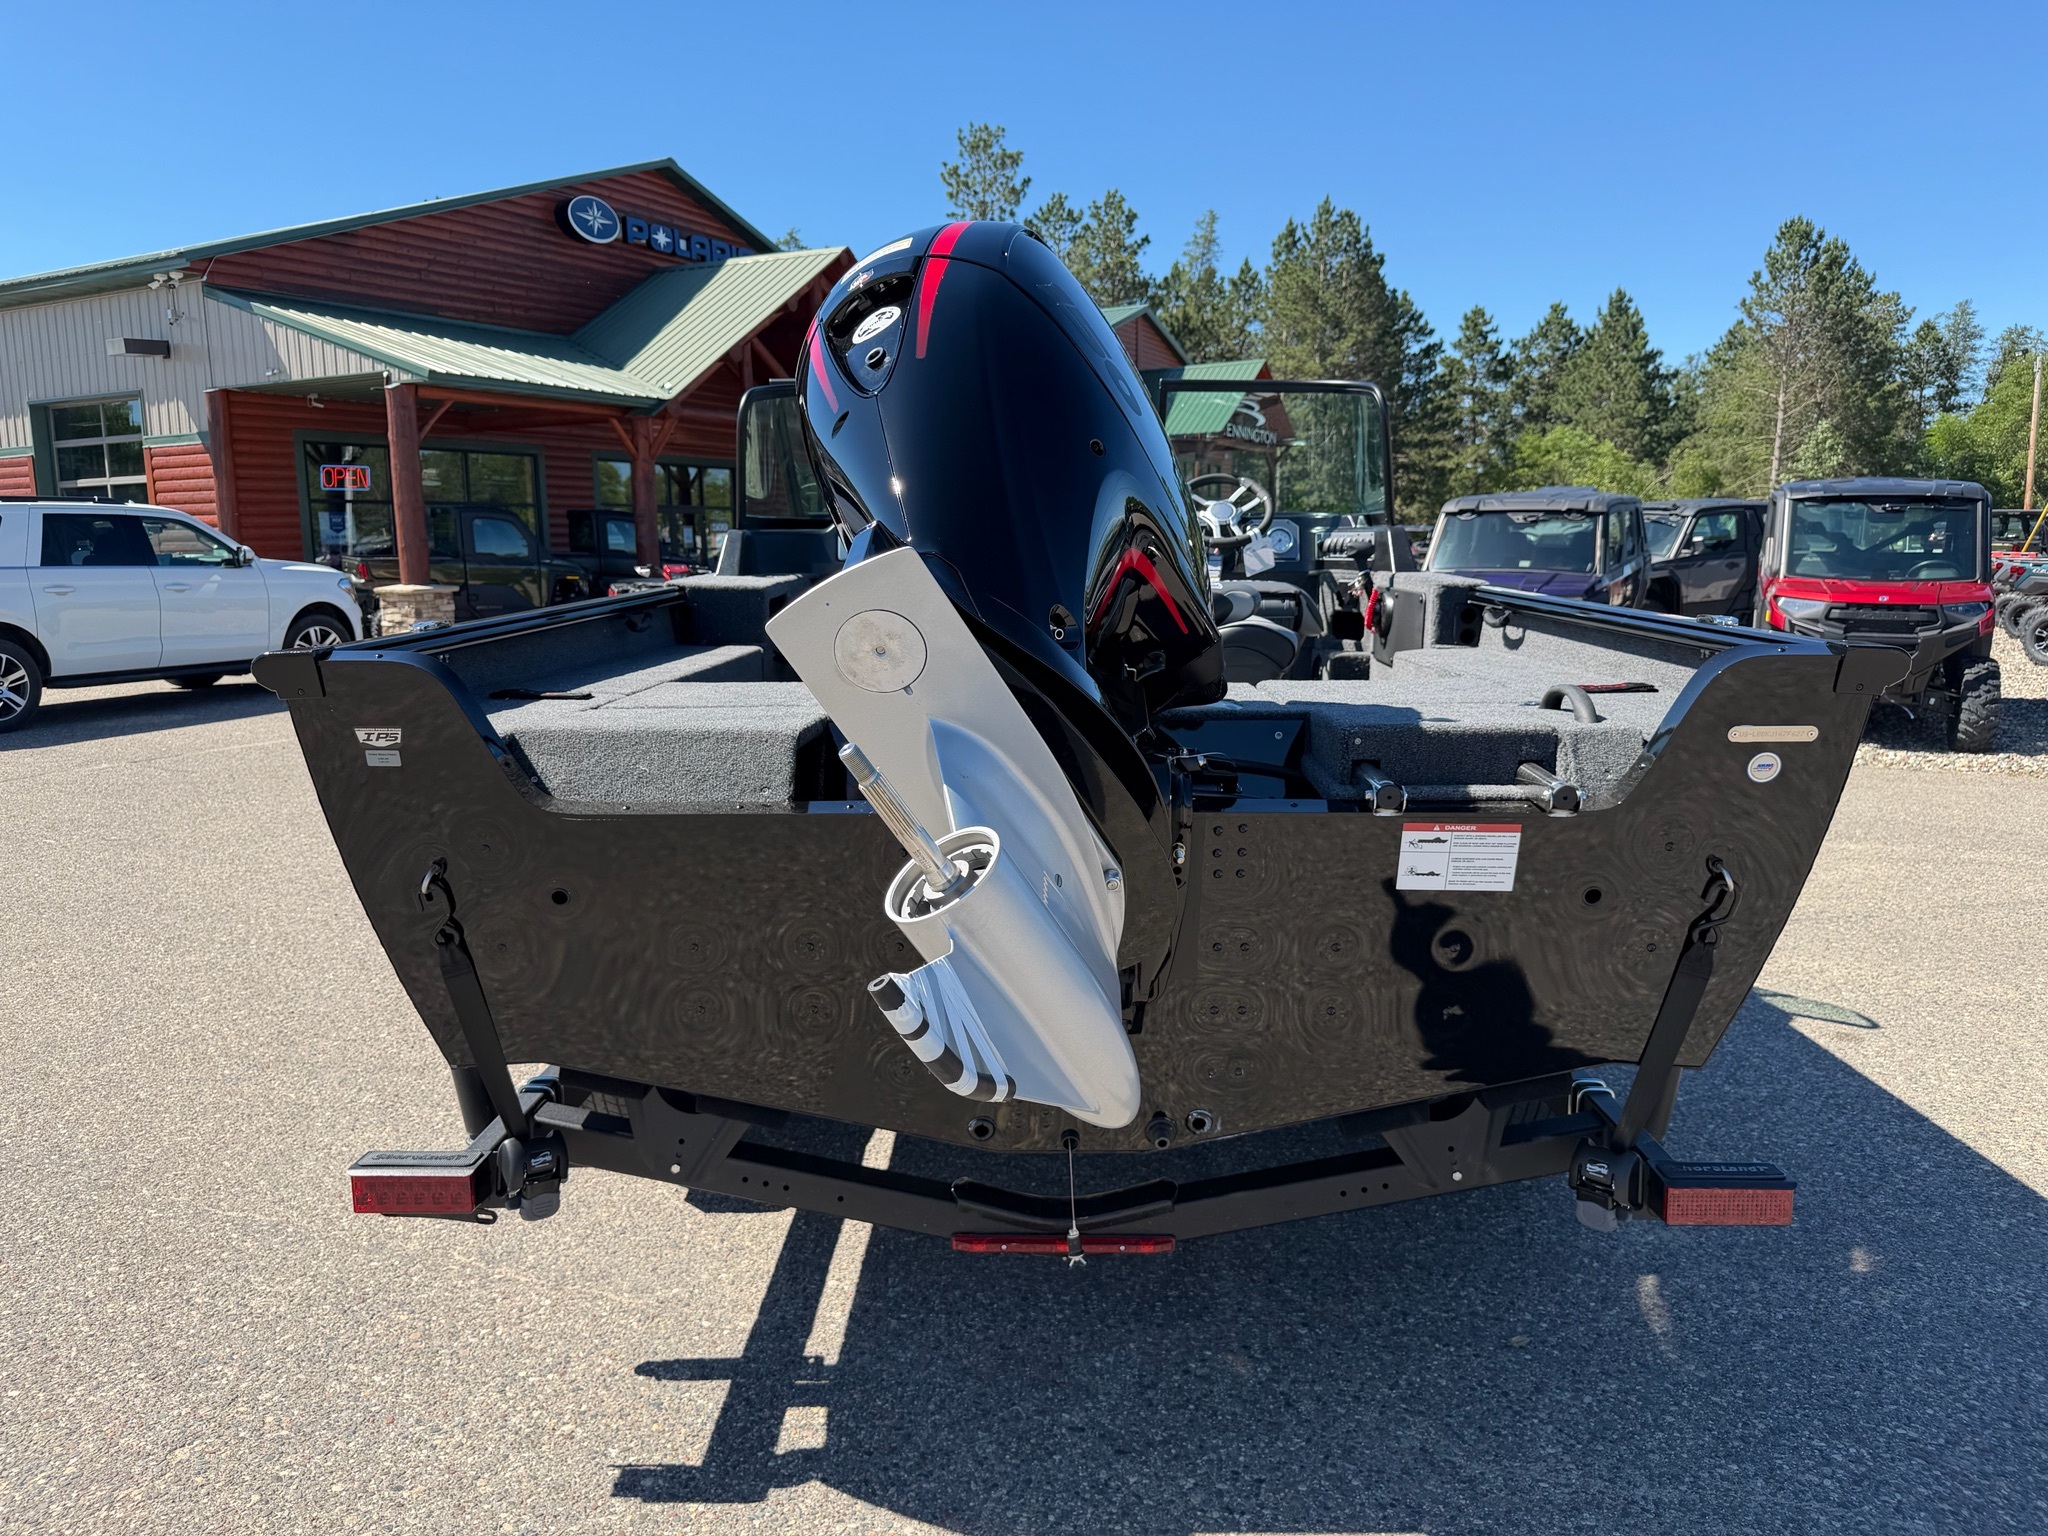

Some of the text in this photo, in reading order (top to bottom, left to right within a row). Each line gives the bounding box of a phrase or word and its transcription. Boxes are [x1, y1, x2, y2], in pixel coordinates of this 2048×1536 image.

[623, 216, 756, 262] POLARI
[1224, 423, 1277, 445] ENNINGTON
[323, 467, 369, 488] OPEN
[362, 732, 399, 741] IPS
